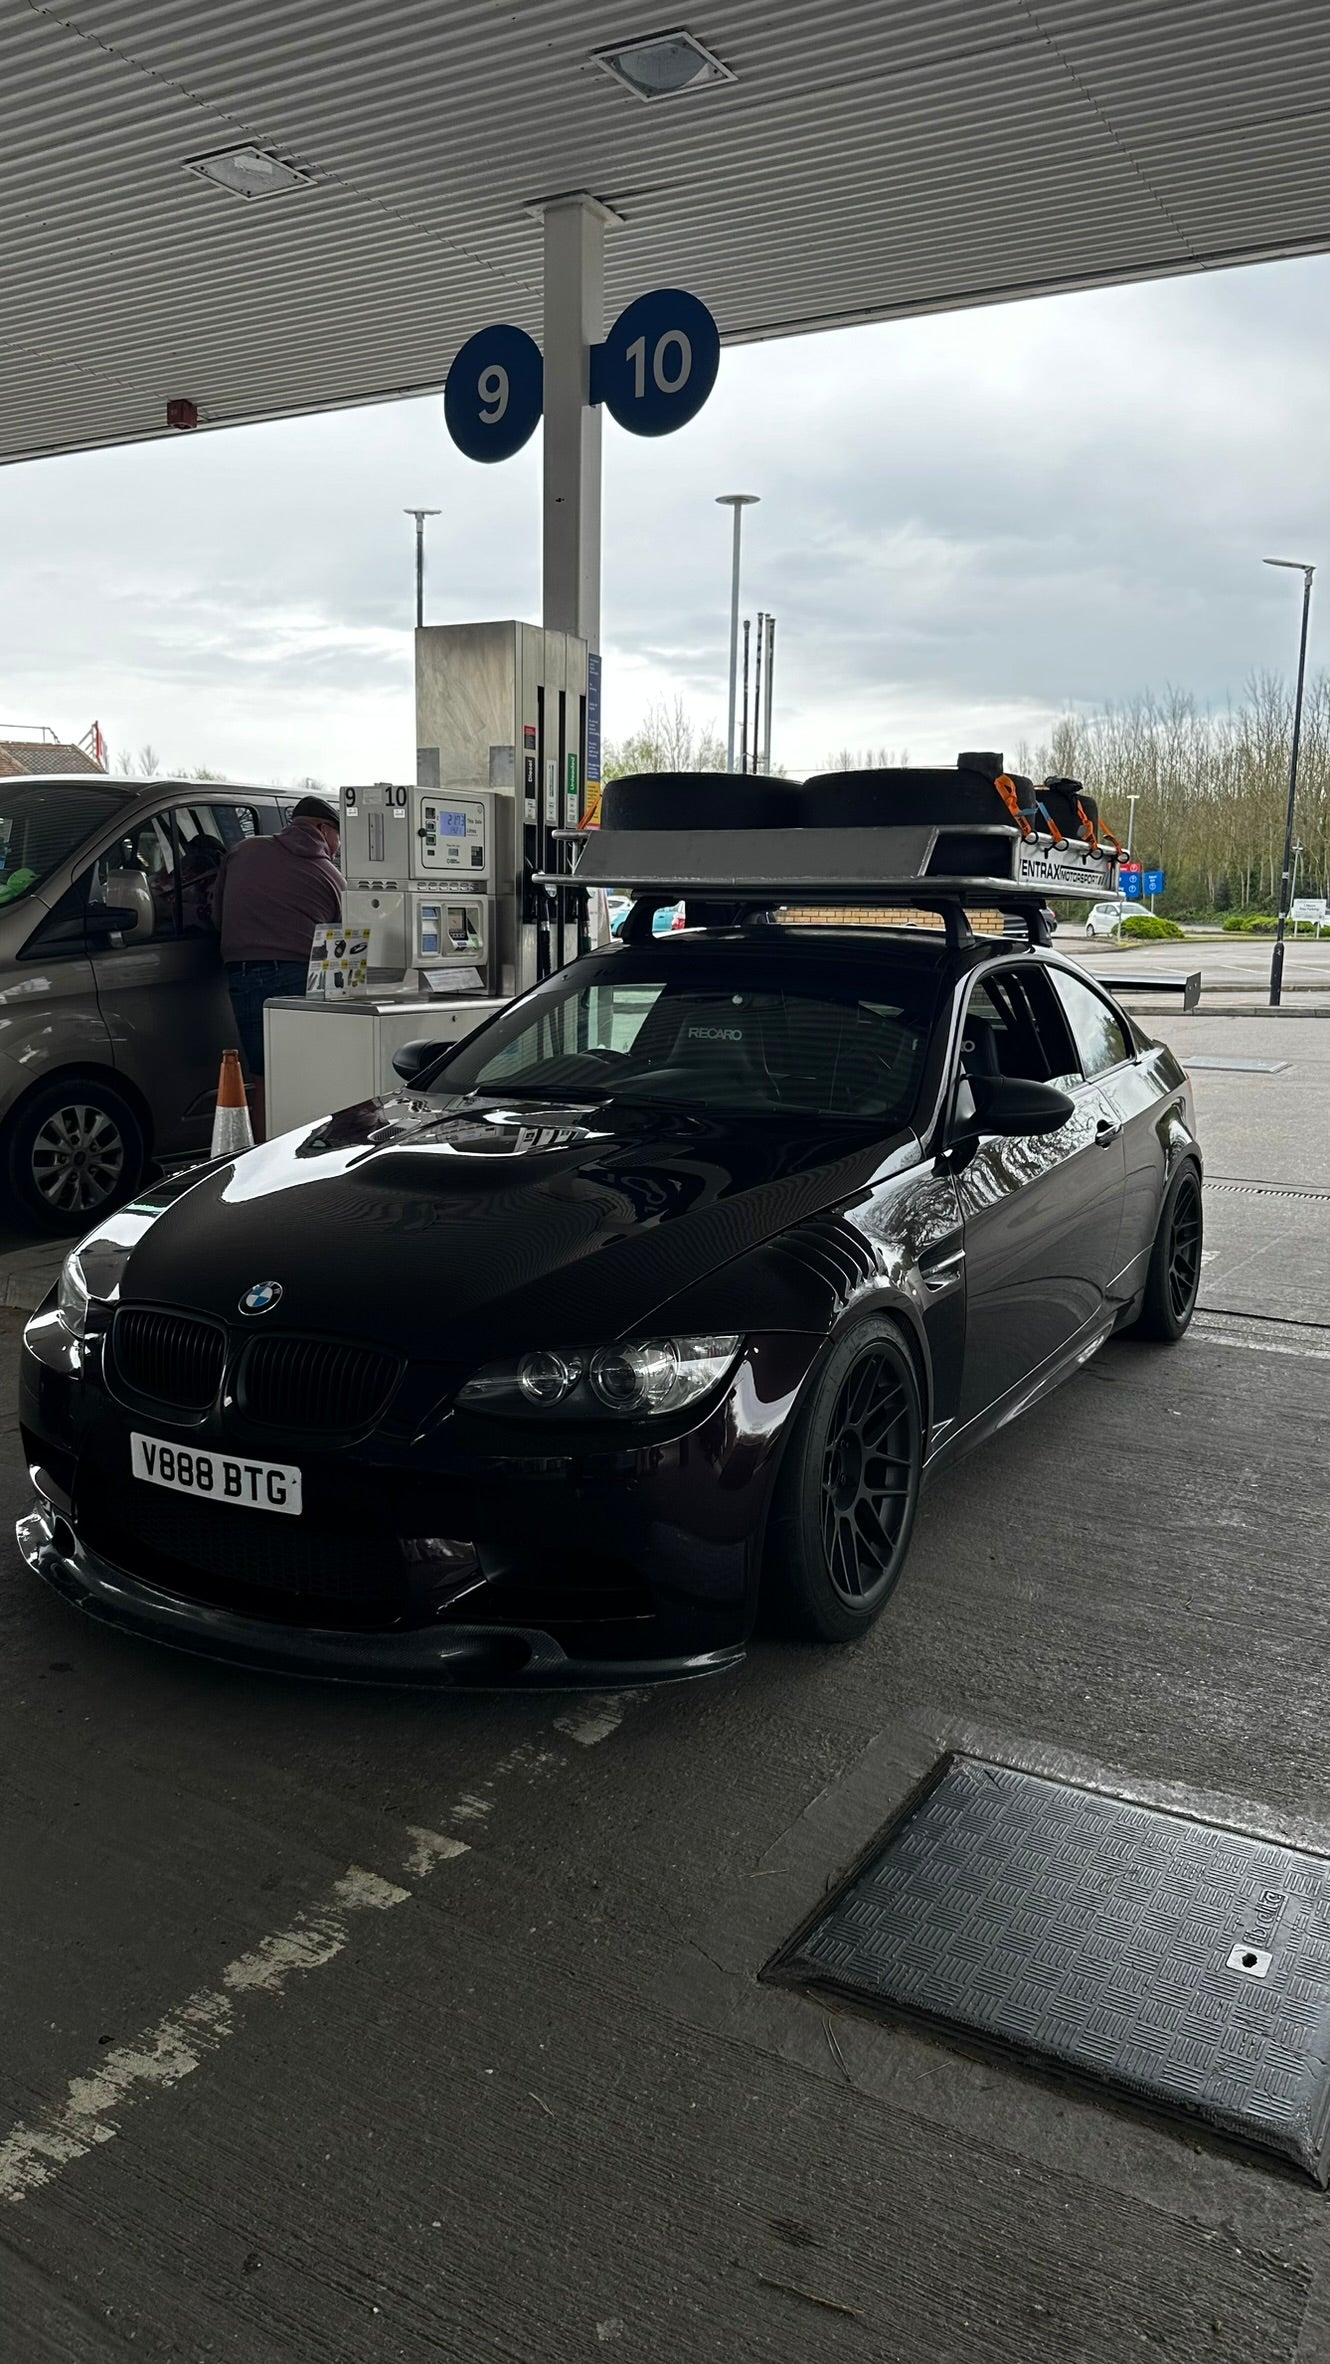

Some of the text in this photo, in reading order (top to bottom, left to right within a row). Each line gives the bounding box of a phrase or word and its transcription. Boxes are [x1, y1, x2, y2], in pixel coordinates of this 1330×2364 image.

[626, 330, 692, 398] 10
[478, 365, 509, 424] 9
[345, 787, 356, 808] 9
[385, 786, 407, 807] 10
[688, 1027, 743, 1040] RECARO
[142, 1441, 286, 1505] V888 BTG
